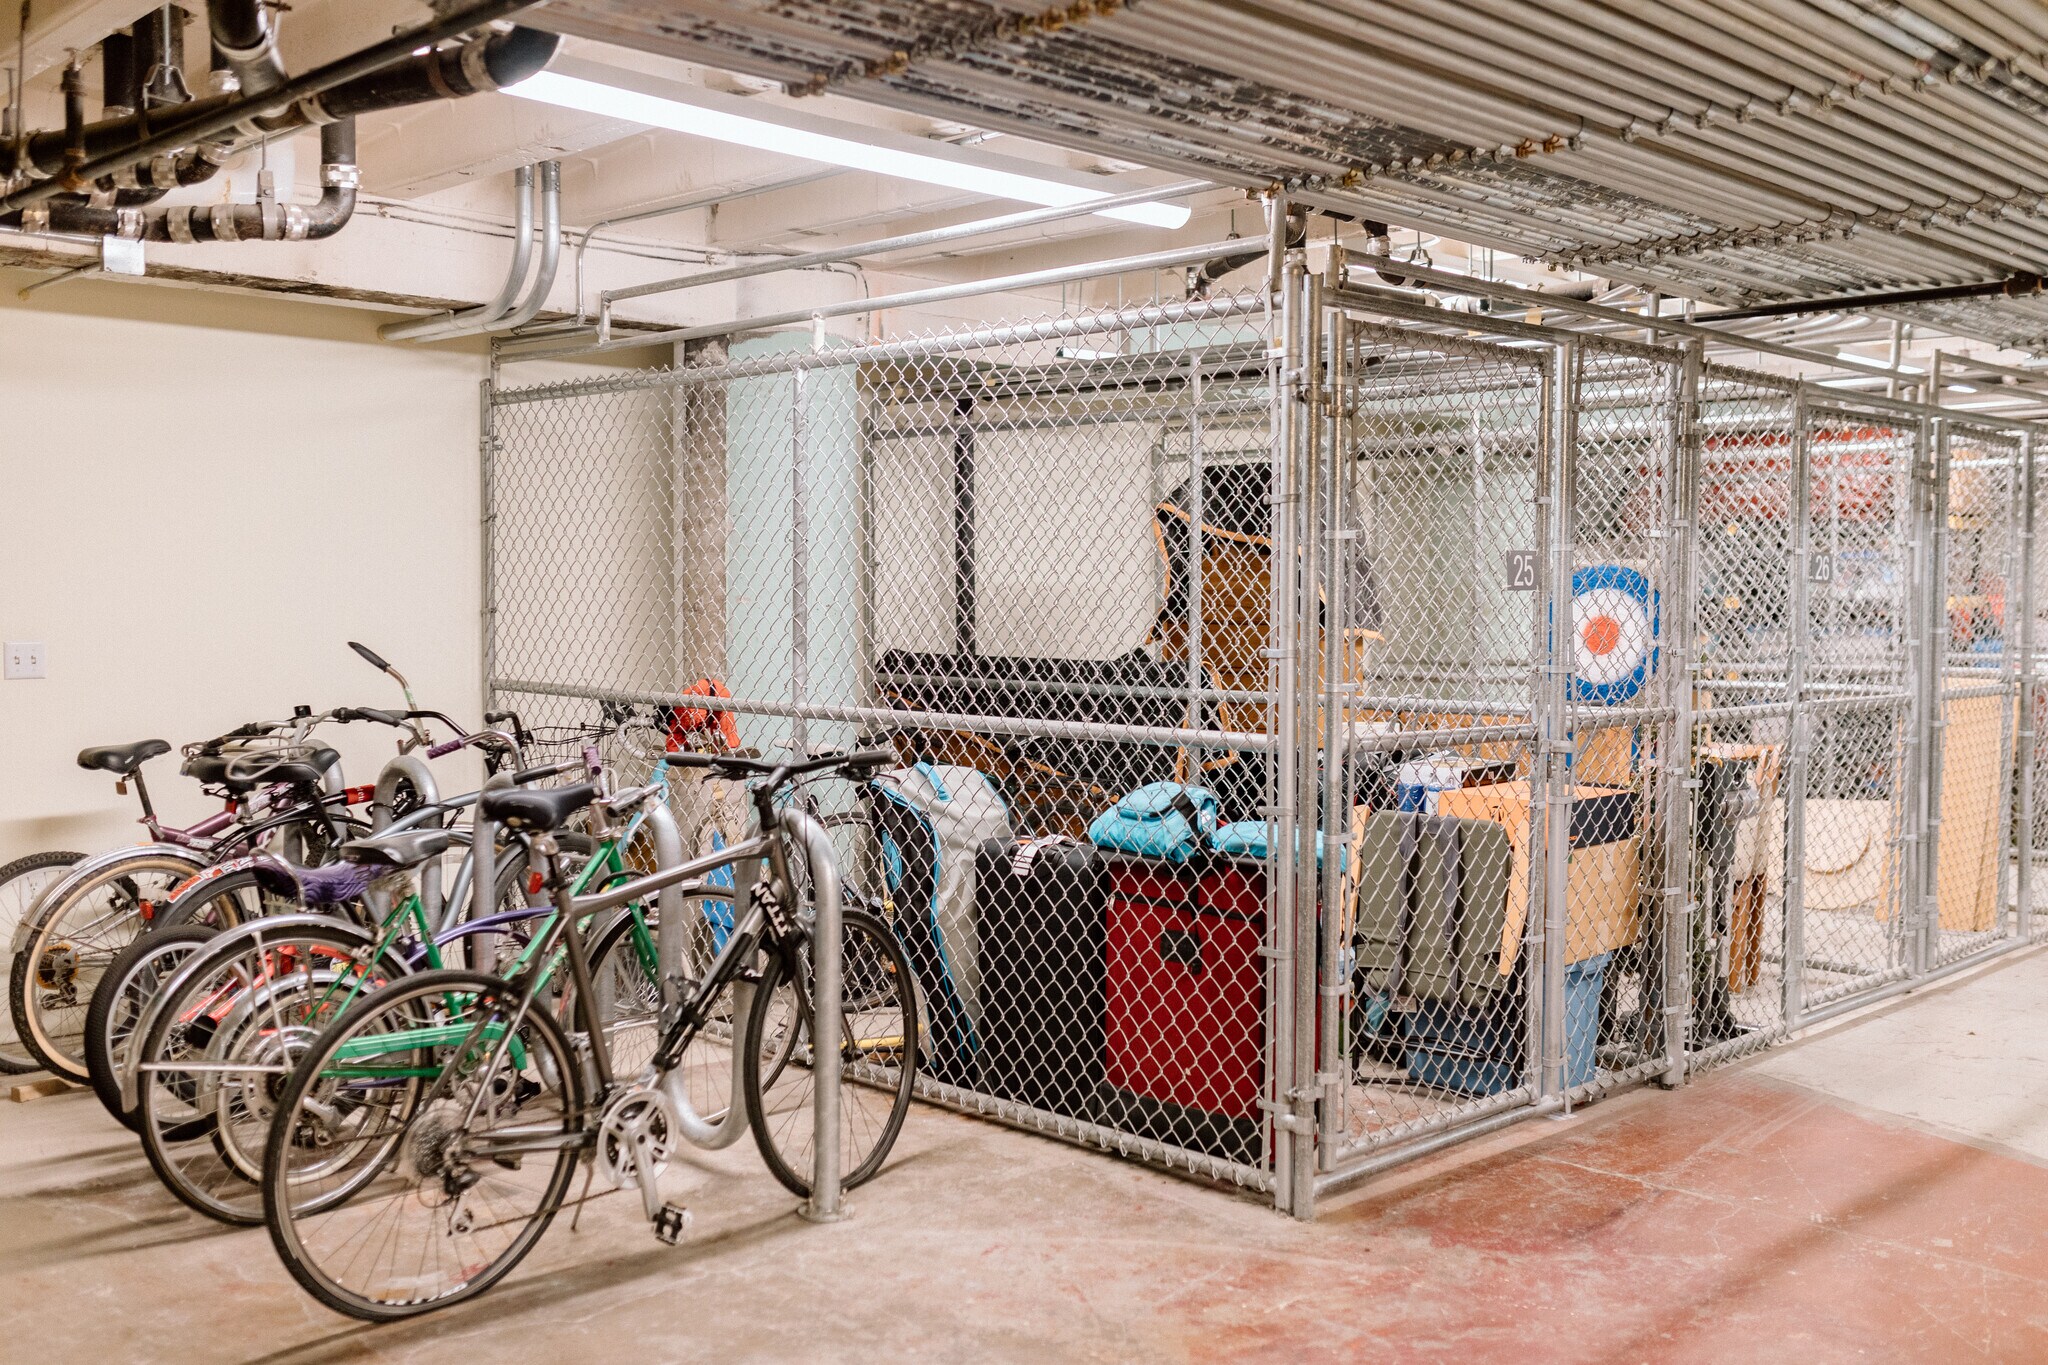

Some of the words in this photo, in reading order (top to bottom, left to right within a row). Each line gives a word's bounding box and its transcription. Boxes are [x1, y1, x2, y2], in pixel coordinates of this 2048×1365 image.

[1513, 554, 1534, 587] 25
[1815, 554, 1830, 581] 26
[750, 881, 791, 938] TITAN
